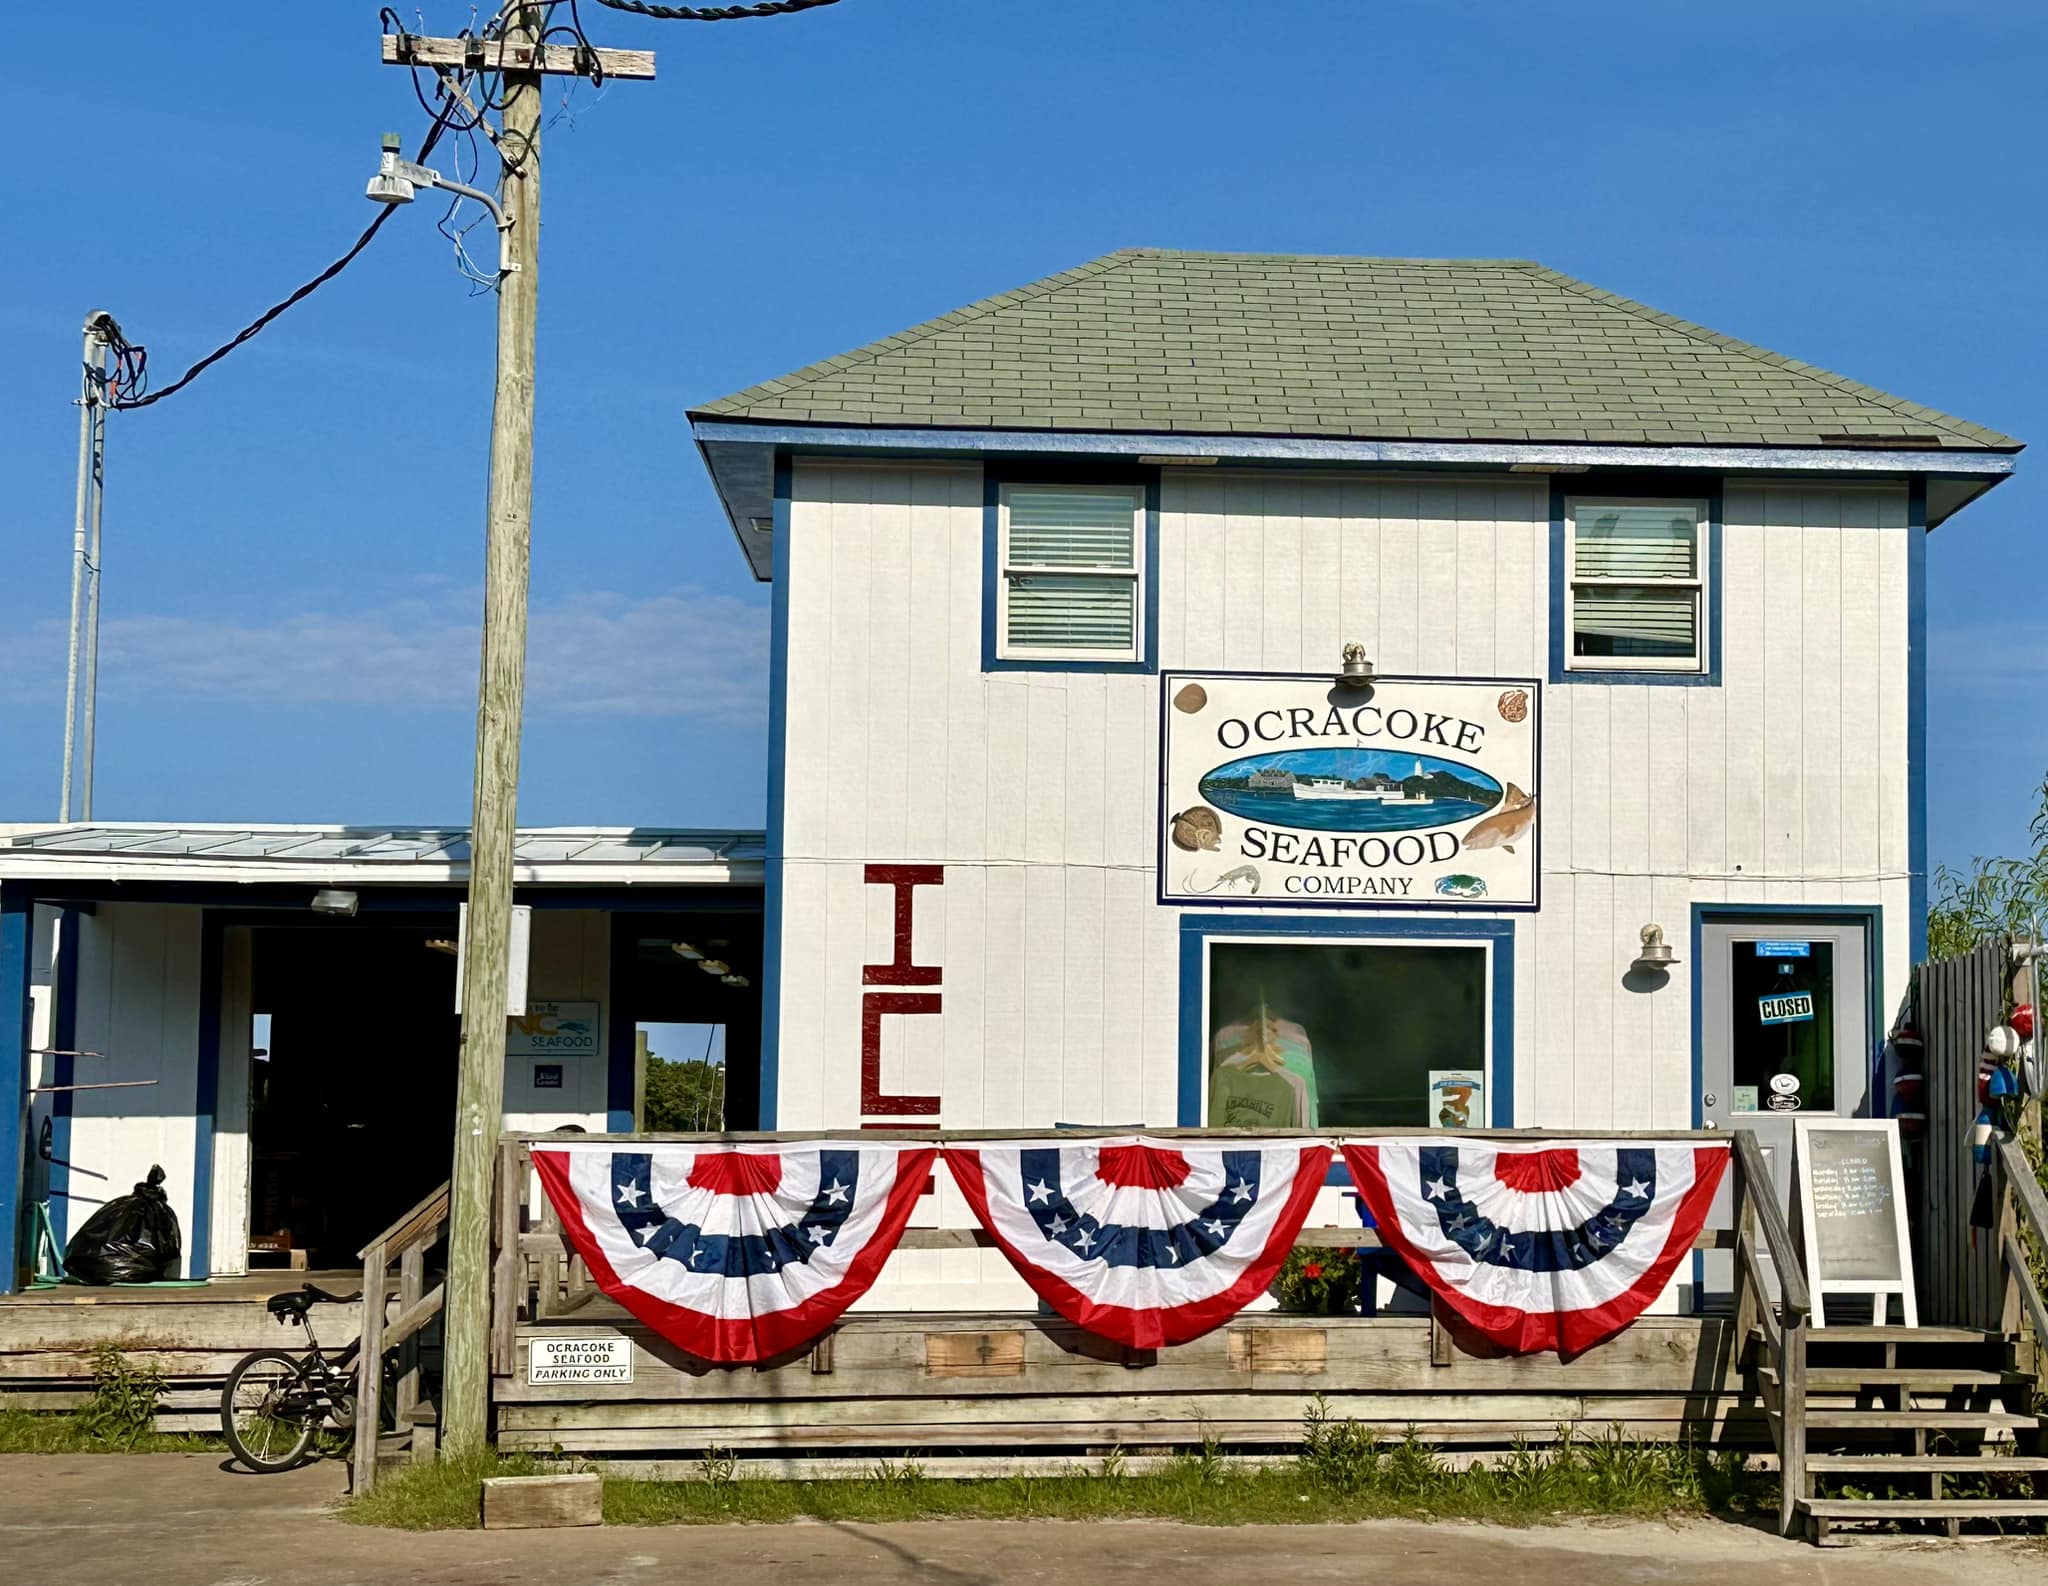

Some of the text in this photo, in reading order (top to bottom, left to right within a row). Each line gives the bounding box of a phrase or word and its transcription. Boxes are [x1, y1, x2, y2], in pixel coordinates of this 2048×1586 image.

[1217, 706, 1485, 754] OCRACOKE
[1240, 827, 1460, 868] SEAFOOD
[1284, 875, 1413, 895] COMPANY
[1762, 997, 1810, 1018] CLOSED
[507, 1013, 559, 1036] NC
[860, 863, 944, 1194] IC
[531, 1036, 593, 1047] SEAFOOD
[546, 1343, 615, 1352] OCRACOKE
[552, 1354, 610, 1364] SEAFOOD
[535, 1369, 626, 1379] PARKING ONLY
